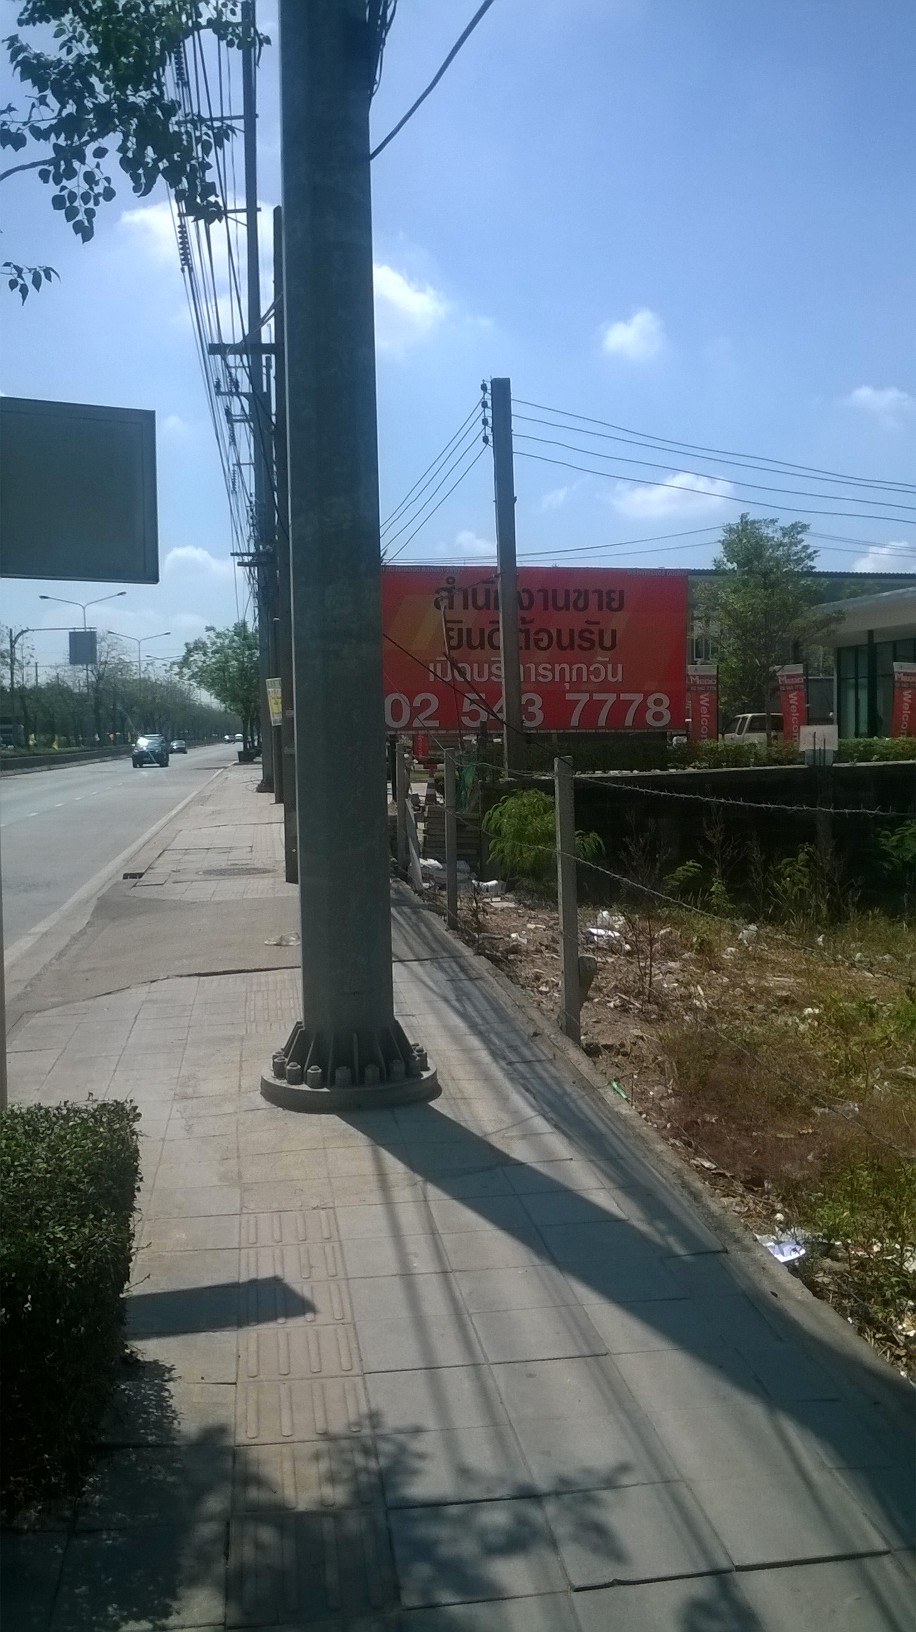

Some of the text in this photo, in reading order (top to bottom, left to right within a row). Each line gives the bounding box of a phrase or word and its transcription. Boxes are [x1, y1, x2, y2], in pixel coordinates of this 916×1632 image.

[433, 576, 625, 613] สำนังานขาย
[428, 656, 623, 690] เปิดบริารทุกวัน
[384, 692, 440, 728] 02
[565, 692, 671, 728] 7778
